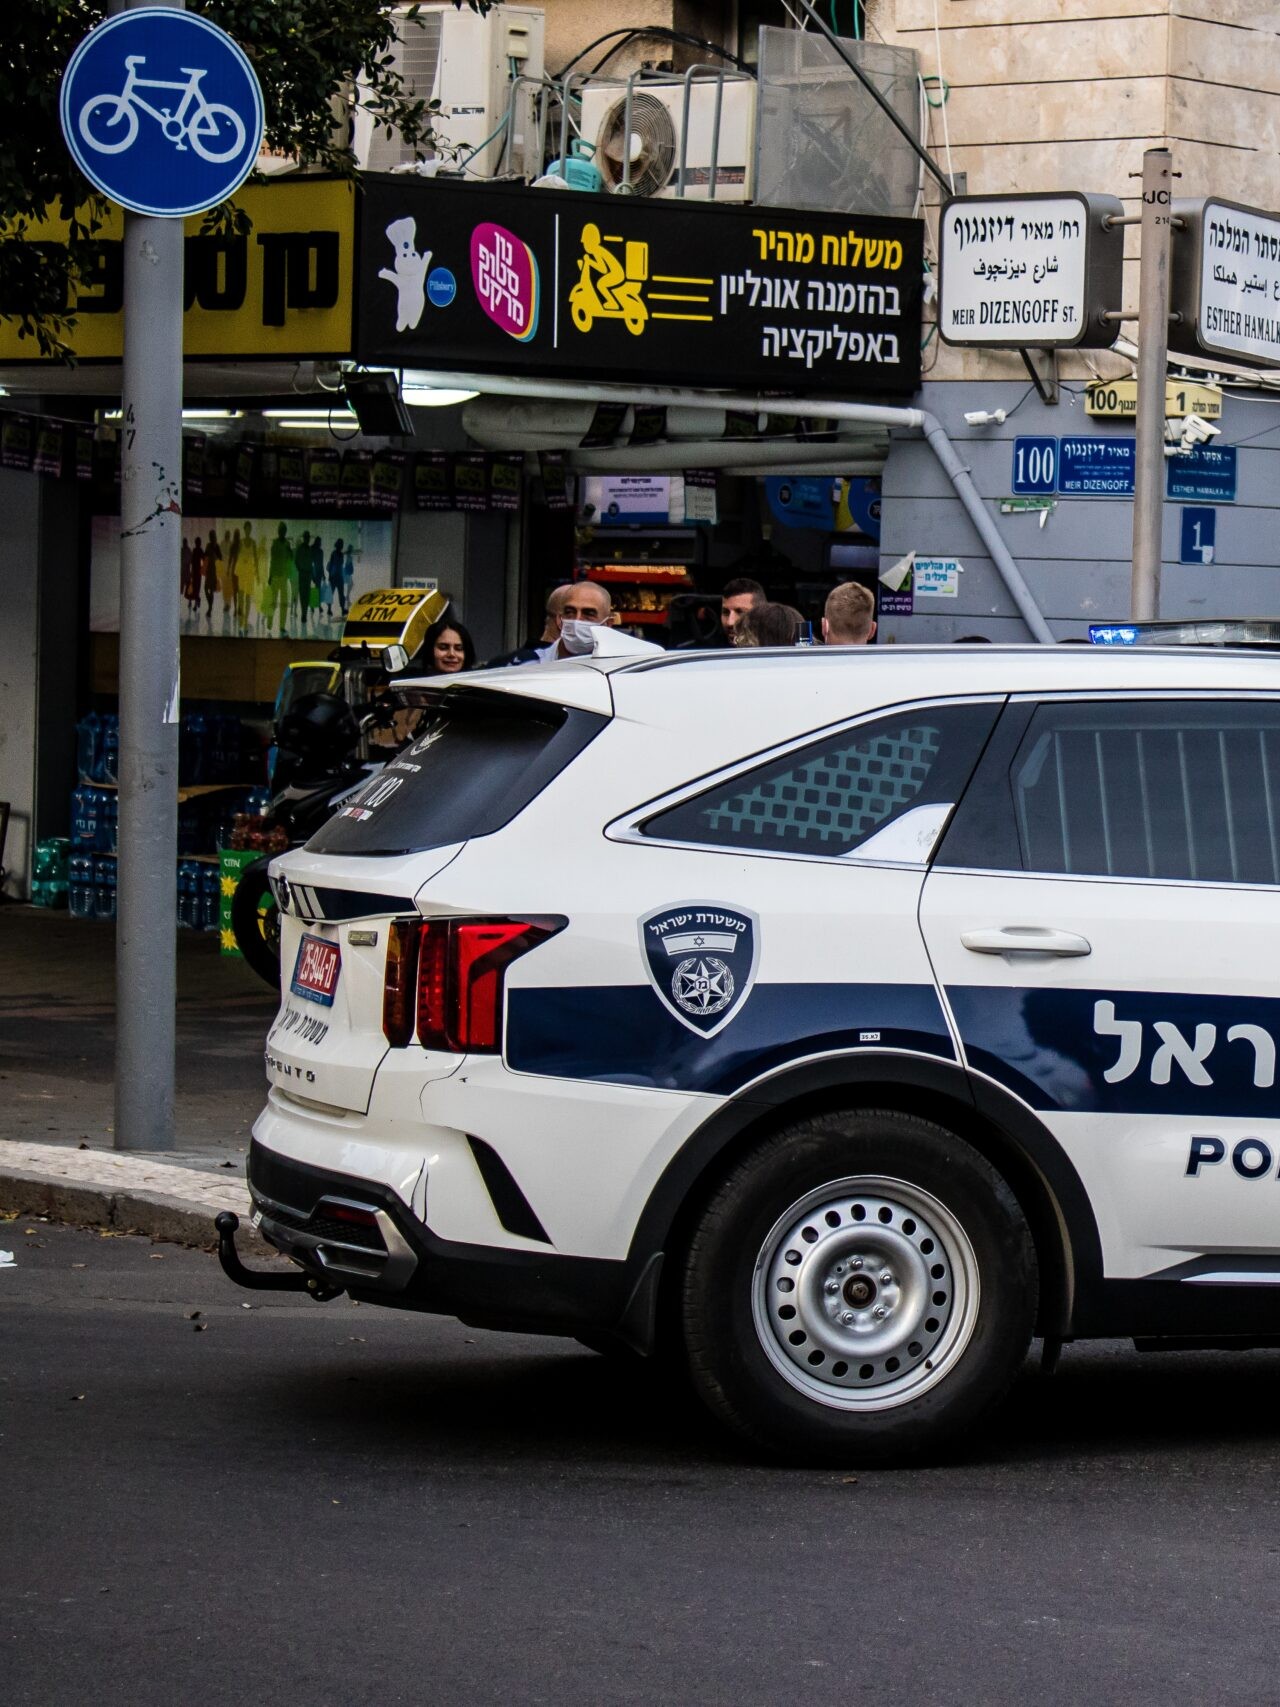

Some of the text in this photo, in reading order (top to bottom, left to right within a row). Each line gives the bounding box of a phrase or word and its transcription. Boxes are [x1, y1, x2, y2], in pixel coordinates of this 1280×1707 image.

[451, 106, 485, 115] ELECTRA
[953, 215, 1015, 251] דיזנגוף
[1021, 220, 1054, 241] מאיר
[1209, 218, 1250, 255] המלכה
[494, 231, 513, 267] נון
[752, 229, 903, 271] משלוח מהיר
[478, 243, 520, 297] סטופ
[1033, 256, 1059, 284] شارع
[478, 260, 524, 327] מרקט
[720, 269, 902, 316] בהזמנה אונליין
[952, 299, 1077, 325] MEIR DIZENGOFF ST.
[1206, 306, 1242, 336] ESTHER
[762, 324, 901, 369] באפליקציה
[1087, 387, 1118, 411] 100
[1176, 391, 1185, 411] 1
[1015, 447, 1054, 484] 100
[1107, 446, 1130, 457] מאיר
[1065, 480, 1081, 489] MEIR
[1083, 479, 1129, 490] DIZENGOFF
[1172, 485, 1195, 494] ESTHER
[1193, 521, 1203, 550] 1
[360, 607, 397, 621] ATM
[648, 912, 748, 936] משטרת ישראל
